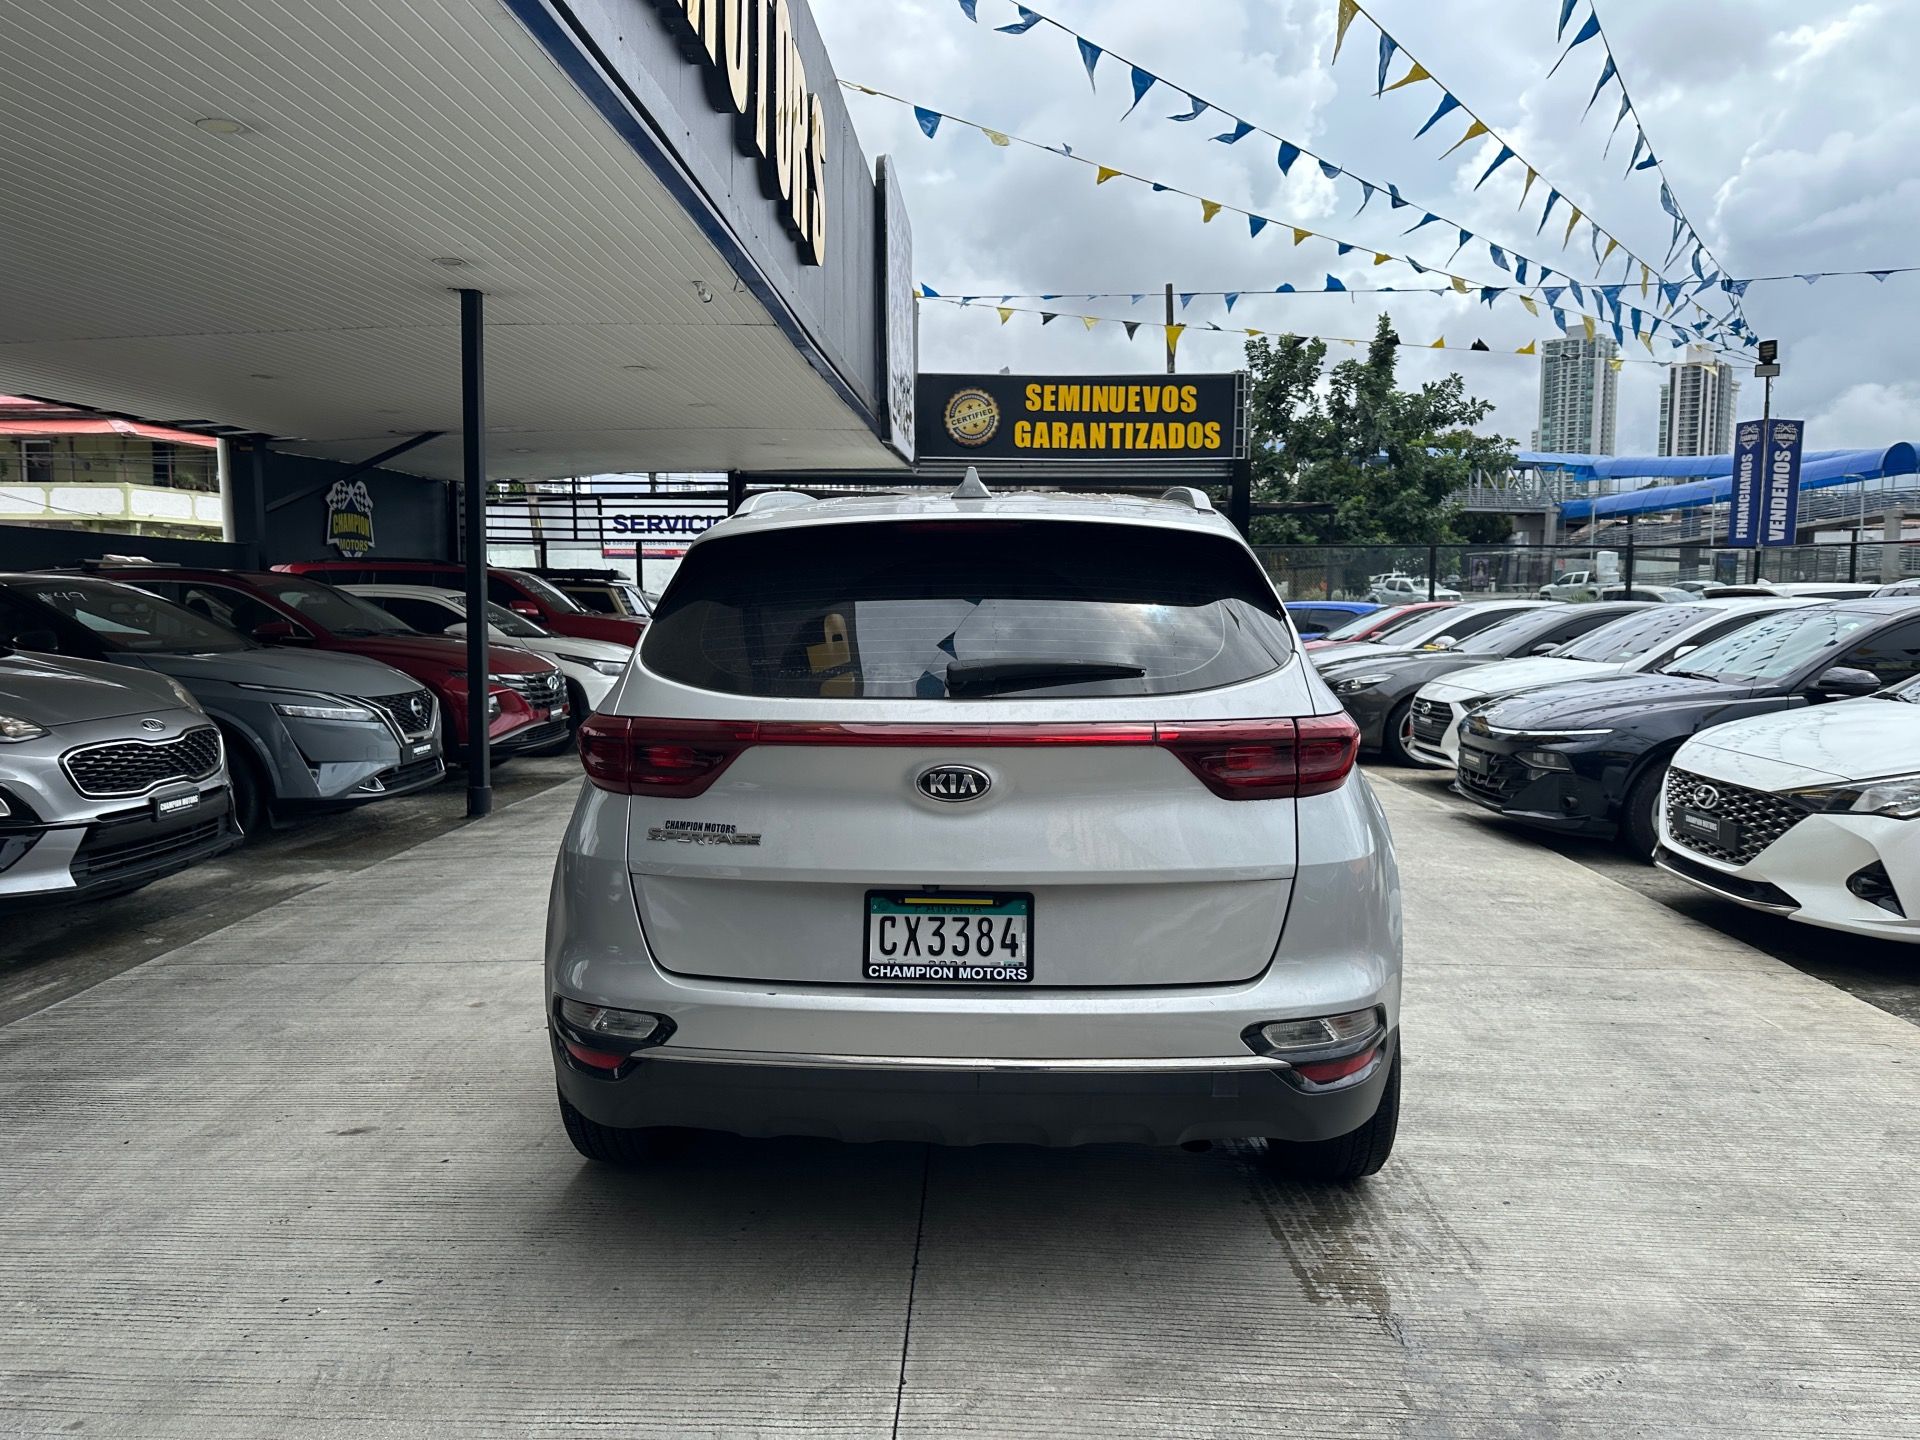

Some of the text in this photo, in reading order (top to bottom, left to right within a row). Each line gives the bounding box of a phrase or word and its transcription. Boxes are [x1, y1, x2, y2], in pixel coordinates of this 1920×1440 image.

[1025, 383, 1198, 413] SEMINUEVOS
[951, 408, 993, 426] CERTIFIED
[1014, 420, 1221, 450] GARANTIZADOS
[1736, 453, 1753, 539] FINANCIAMOS
[1768, 450, 1792, 541] VENDEMOS
[333, 513, 370, 538] CHAMPION
[340, 539, 369, 552] MOTORS
[929, 773, 978, 794] KIA
[646, 828, 761, 845] SPORTAGE
[665, 820, 736, 834] CHAMPION MOTORS
[879, 915, 1019, 957] CX3384
[868, 965, 1028, 980] CHAMPION MOTORS
